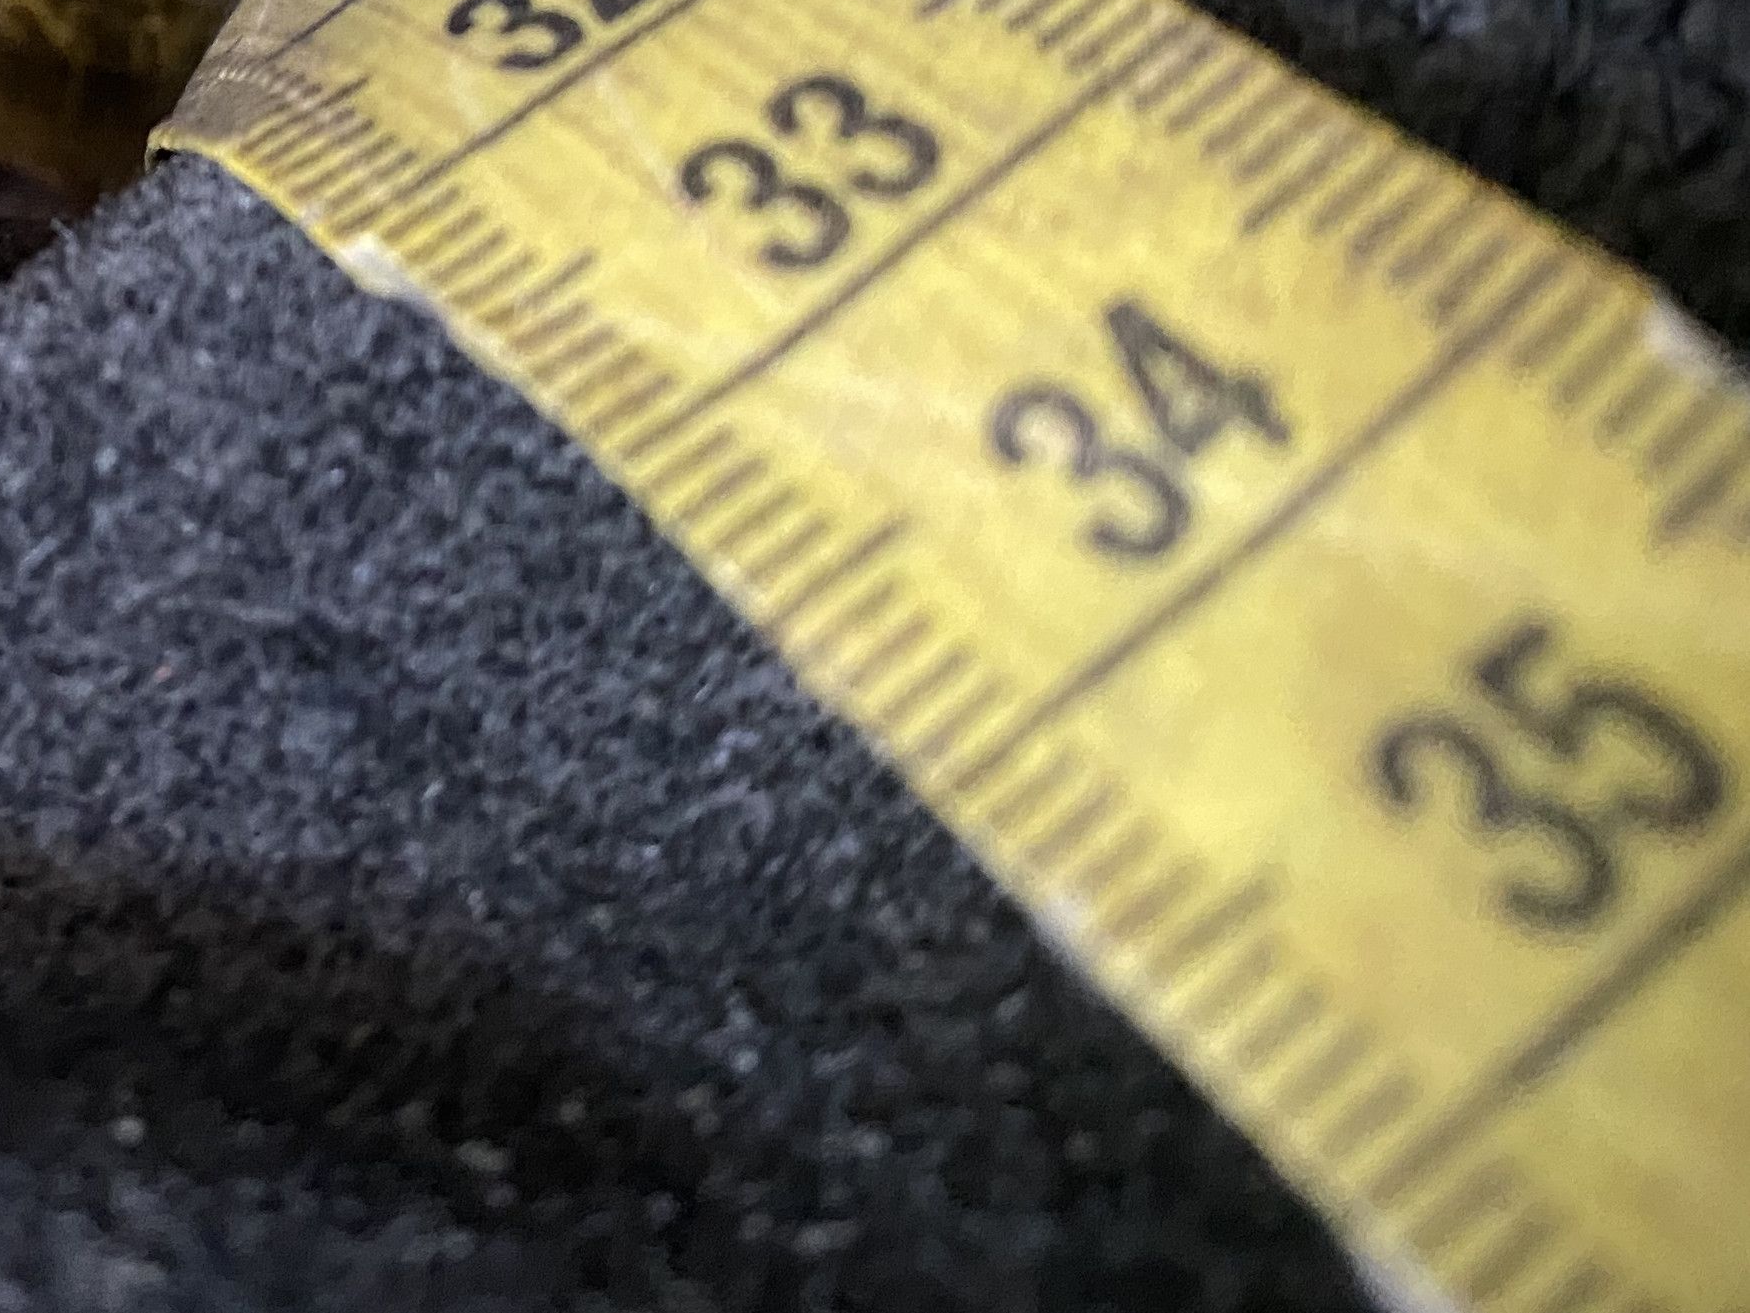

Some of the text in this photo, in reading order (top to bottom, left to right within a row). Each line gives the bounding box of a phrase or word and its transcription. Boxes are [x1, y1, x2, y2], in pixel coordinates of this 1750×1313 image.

[680, 76, 942, 272] 33
[986, 300, 1292, 558] 34
[1375, 622, 1728, 930] 35
